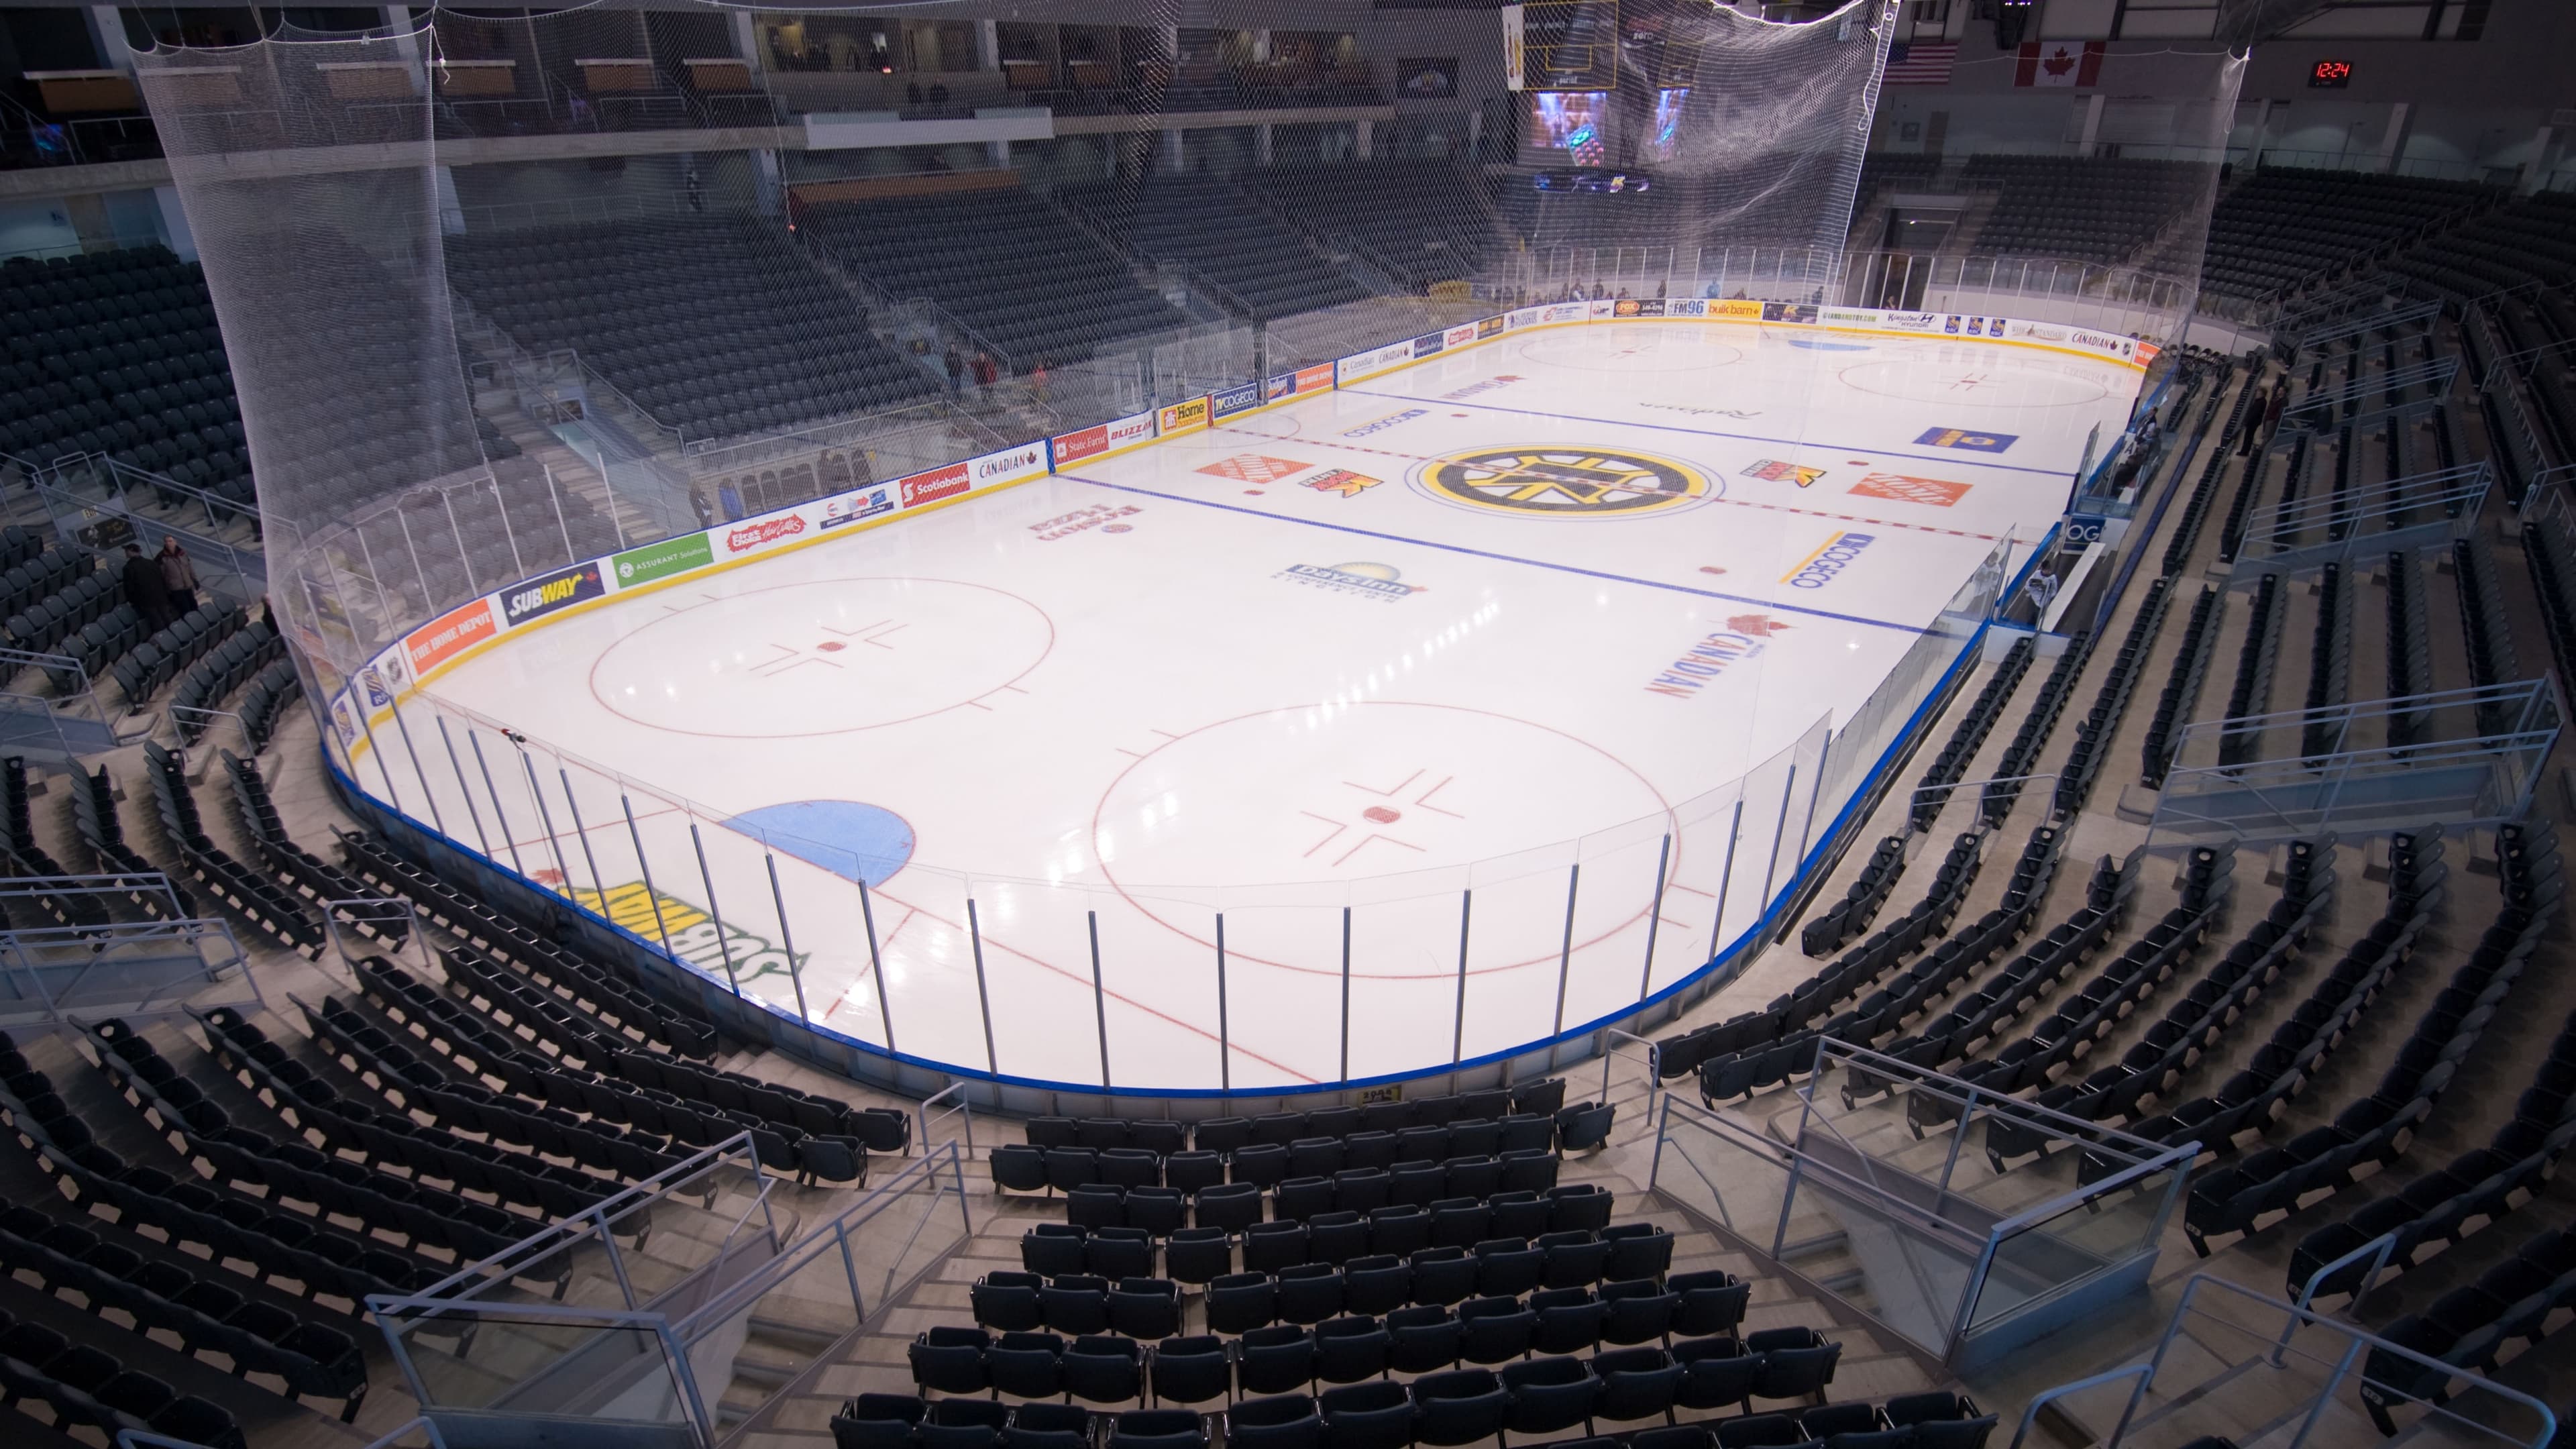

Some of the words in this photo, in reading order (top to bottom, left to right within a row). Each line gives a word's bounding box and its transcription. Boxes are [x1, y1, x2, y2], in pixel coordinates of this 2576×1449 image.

[2316, 62, 2349, 77] 12:24
[1709, 303, 1729, 314] bulk
[1730, 305, 1753, 316] barn
[2072, 333, 2110, 349] CANADIAN
[1177, 403, 1205, 419] Home
[1069, 440, 1086, 452] State
[1087, 435, 1106, 448] Farm
[979, 453, 1026, 478] CANADIAN
[917, 472, 969, 495] Scotiabank
[637, 554, 678, 571] ASSURANT
[680, 547, 708, 559] Solutions
[508, 572, 584, 617] SUBWAY
[411, 642, 431, 662] THE
[431, 627, 460, 650] HOME
[458, 611, 492, 635] DEPOT
[1643, 633, 1755, 699] CANADIAN
